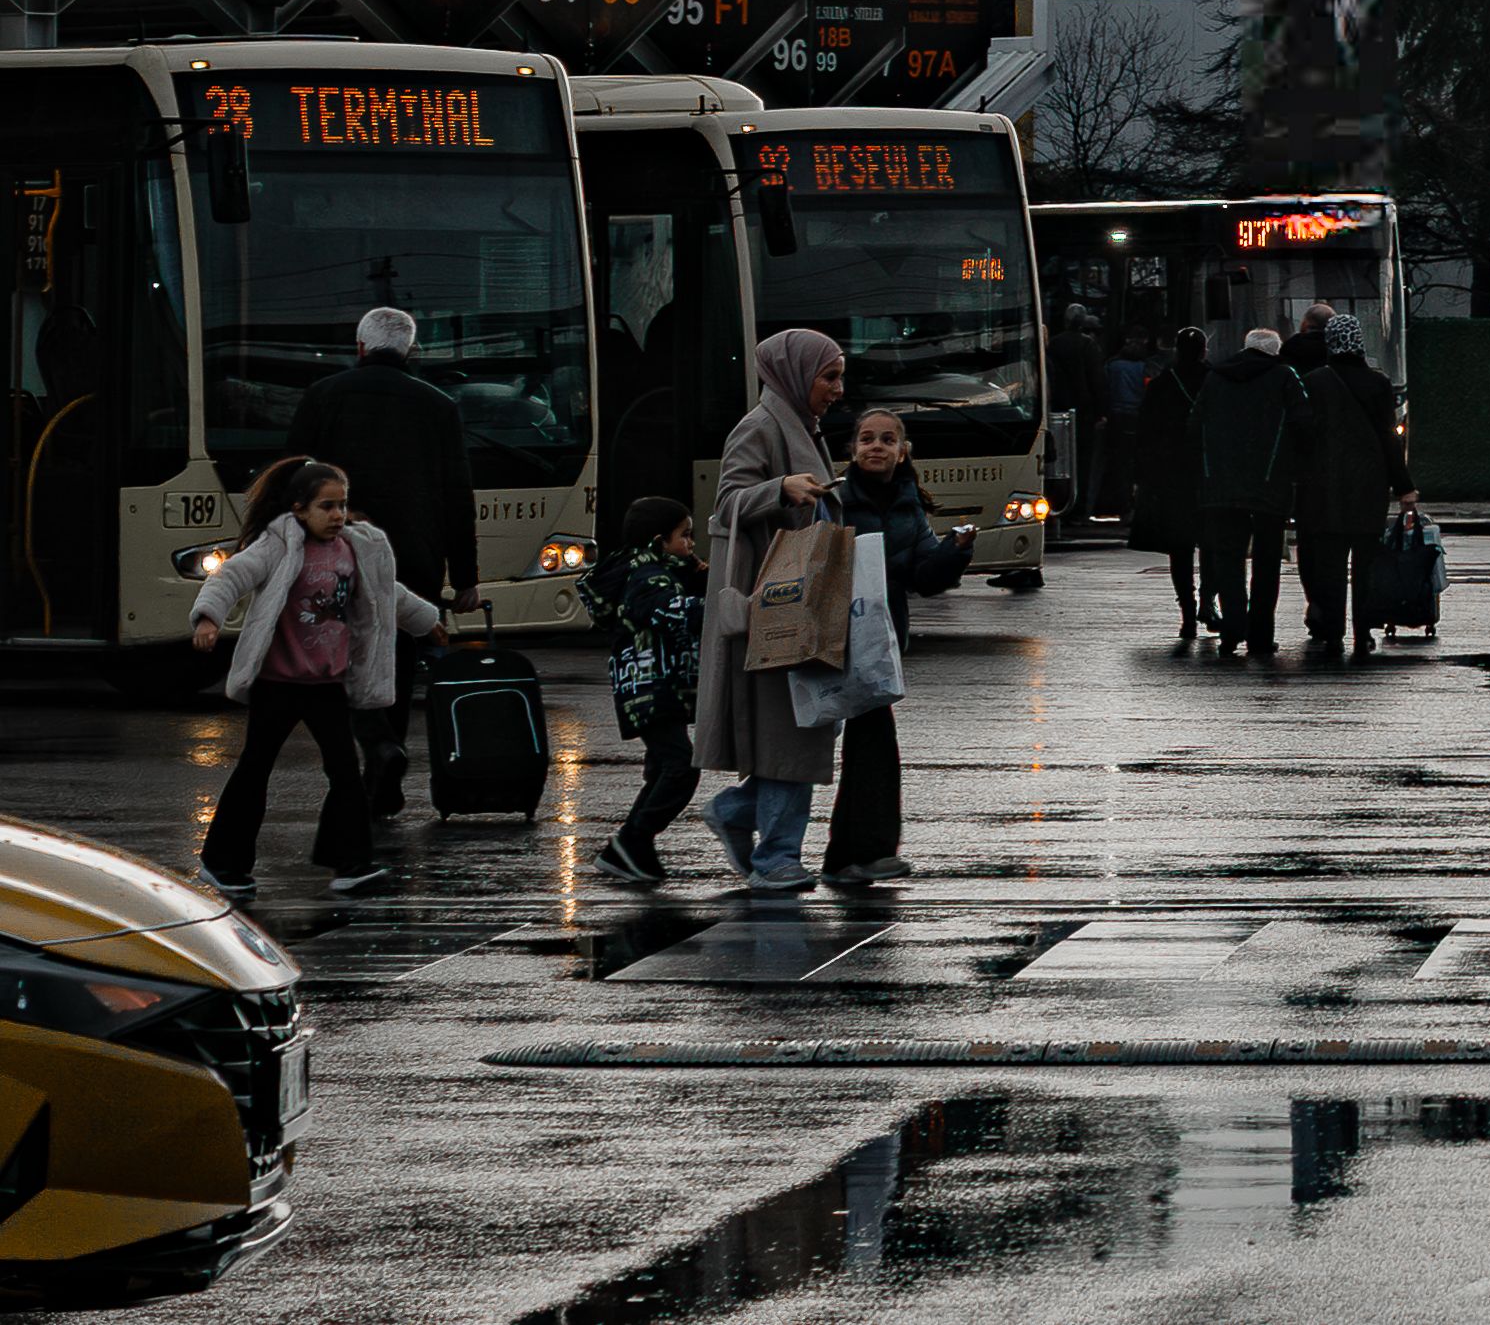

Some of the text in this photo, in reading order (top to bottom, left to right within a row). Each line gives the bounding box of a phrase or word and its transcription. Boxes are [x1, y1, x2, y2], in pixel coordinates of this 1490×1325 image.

[817, 26, 852, 49] 18B
[773, 38, 808, 72] 96
[816, 51, 839, 73] 99
[907, 49, 958, 79] 97A
[28, 213, 45, 232] 91
[922, 463, 1004, 484] BELEDİYESİ
[180, 494, 216, 526] 189
